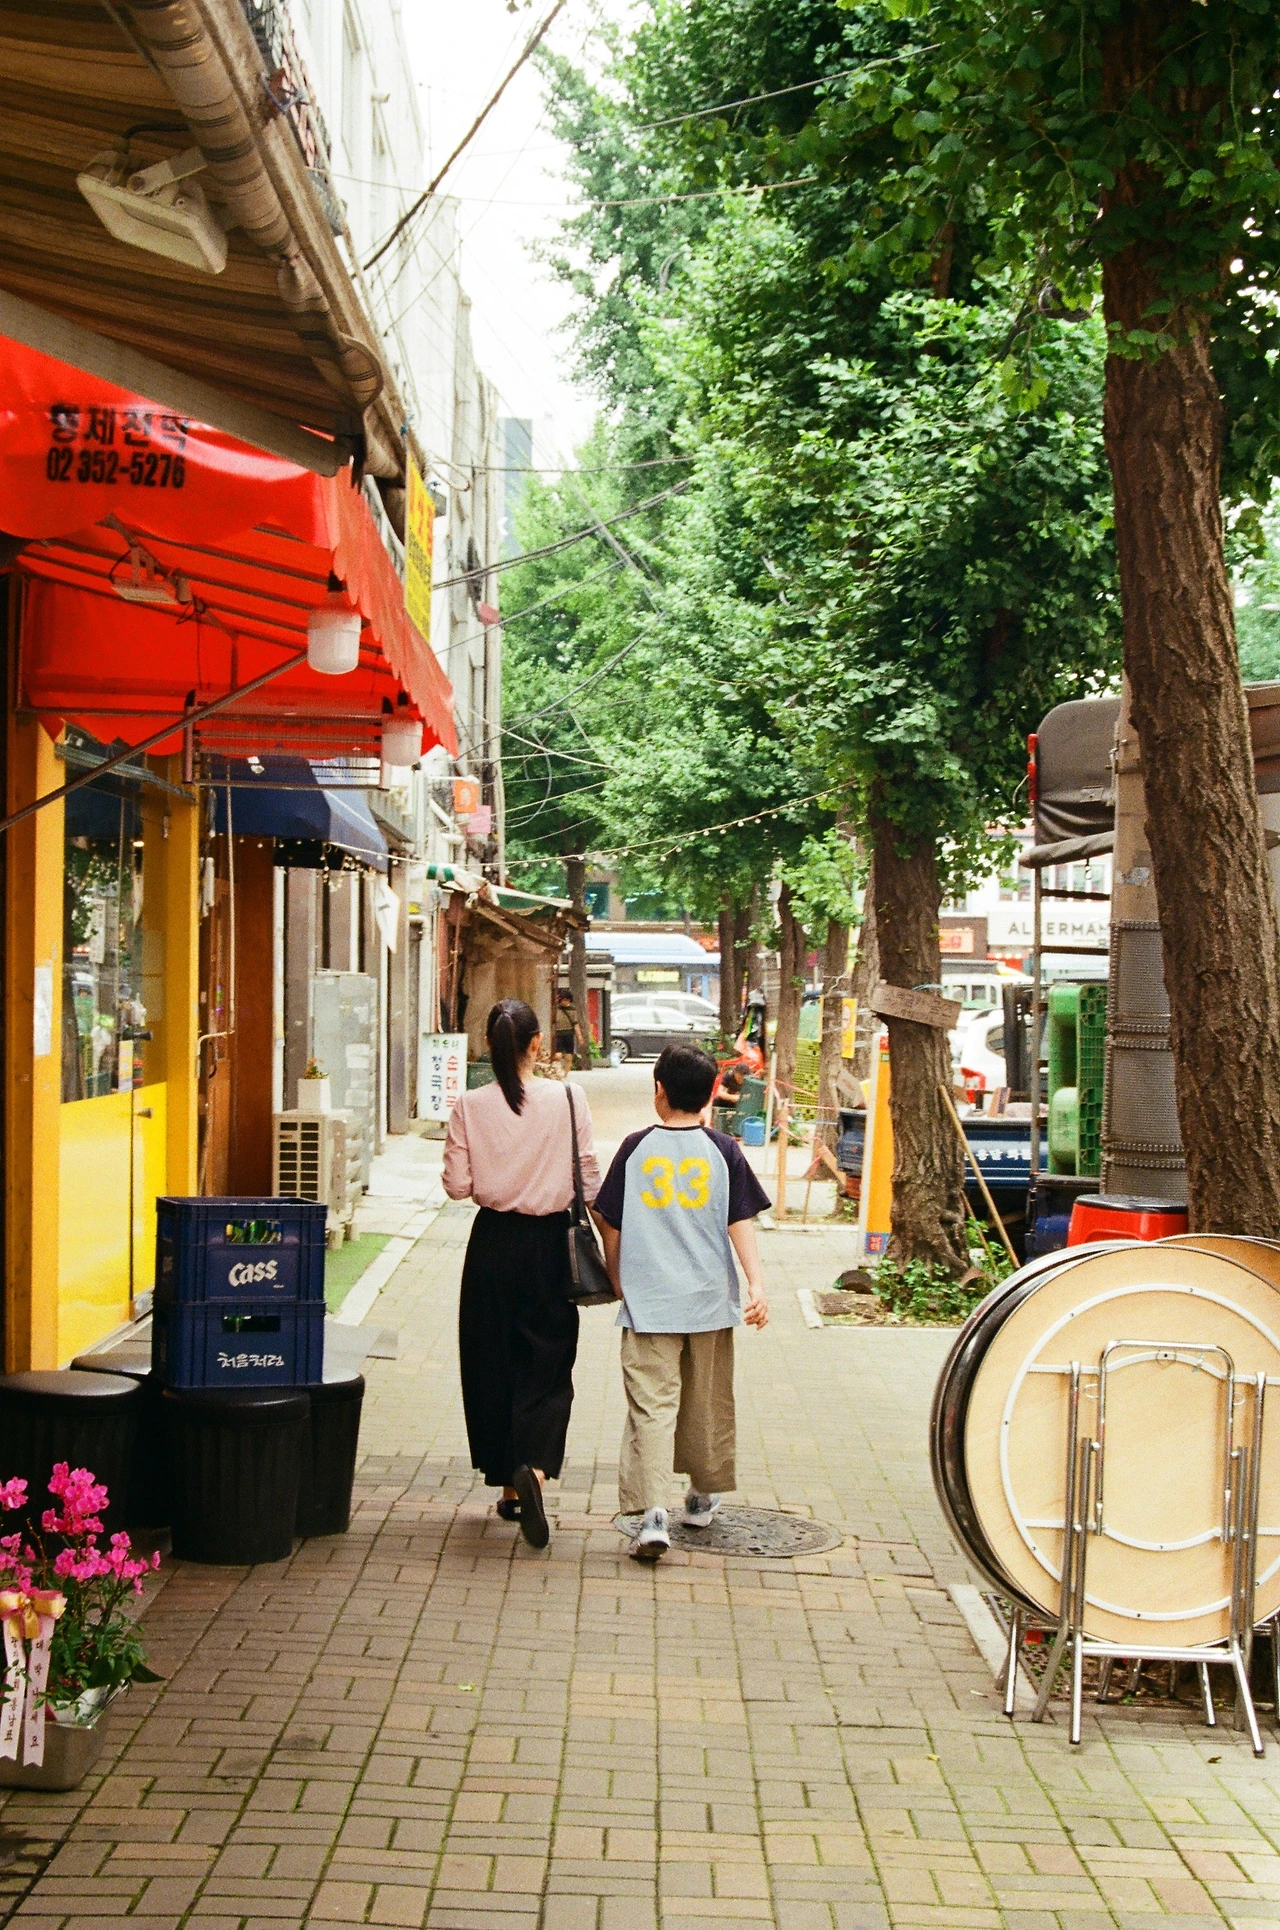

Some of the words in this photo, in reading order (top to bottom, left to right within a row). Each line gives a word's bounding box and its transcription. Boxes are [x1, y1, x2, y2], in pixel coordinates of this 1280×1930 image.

[46, 447, 73, 482] 02
[77, 449, 186, 488] 352-5276
[1007, 921, 1108, 936] ALERMA
[641, 1156, 711, 1209] 33
[216, 1351, 285, 1369] 처음처럼
